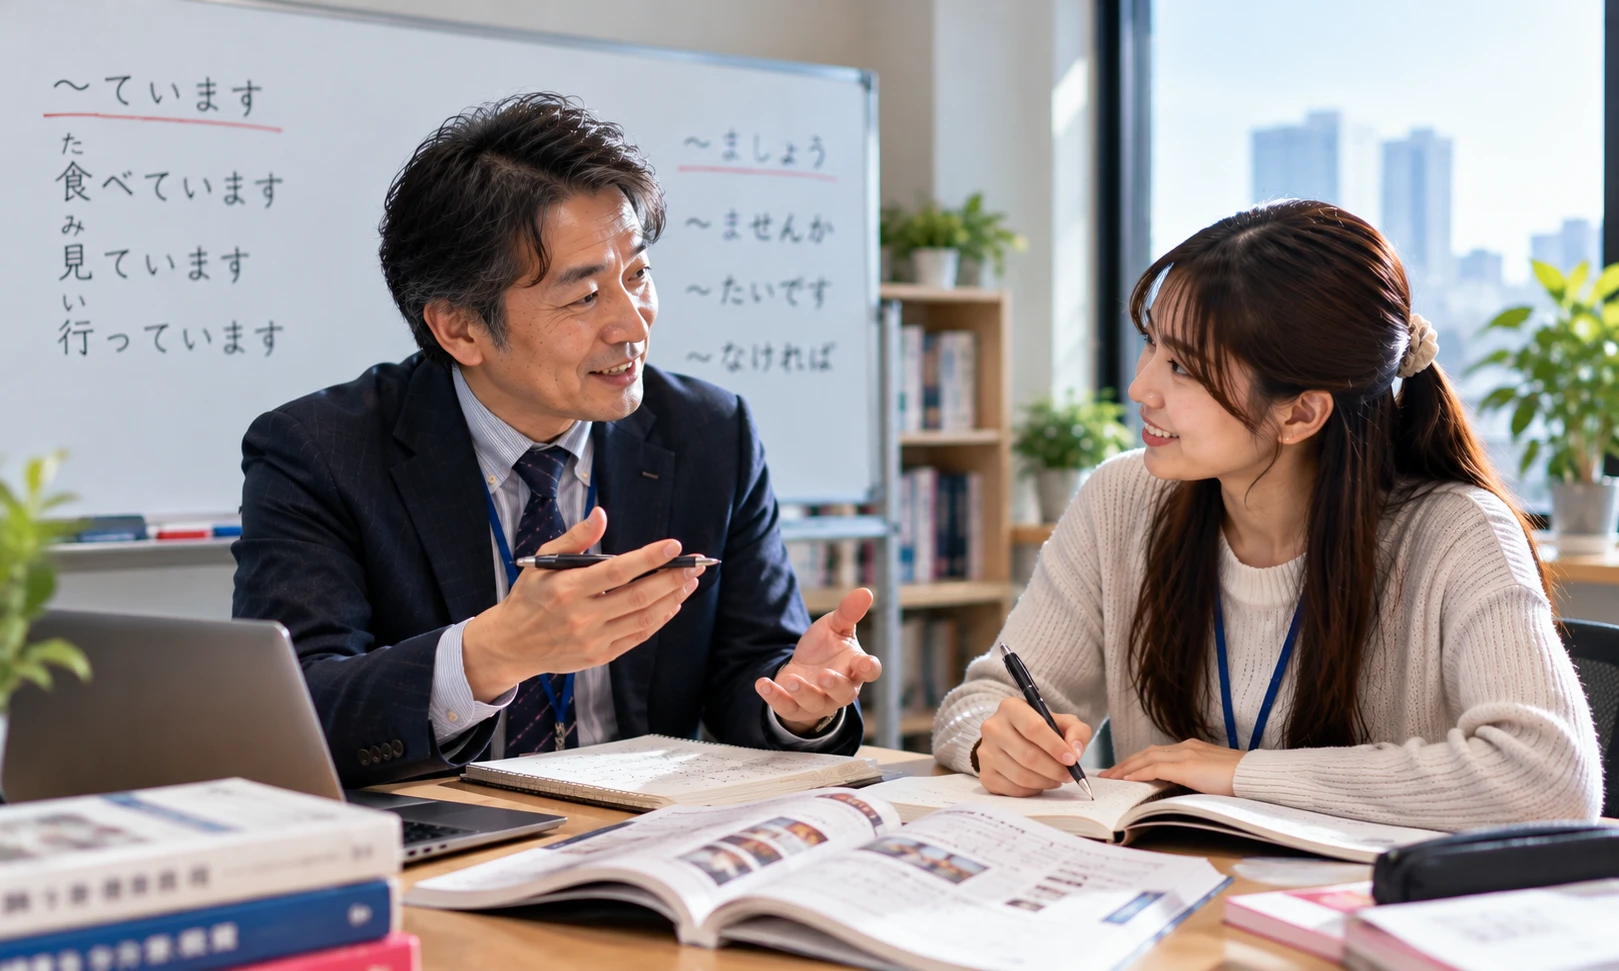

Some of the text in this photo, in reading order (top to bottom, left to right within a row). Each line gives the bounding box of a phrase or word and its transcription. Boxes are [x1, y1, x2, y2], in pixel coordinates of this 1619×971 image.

[61, 132, 84, 155] た
[55, 160, 284, 209] 食べています
[61, 214, 86, 236] み
[58, 243, 251, 285] 見ています
[62, 294, 86, 313] い
[57, 319, 285, 358] 行っています
